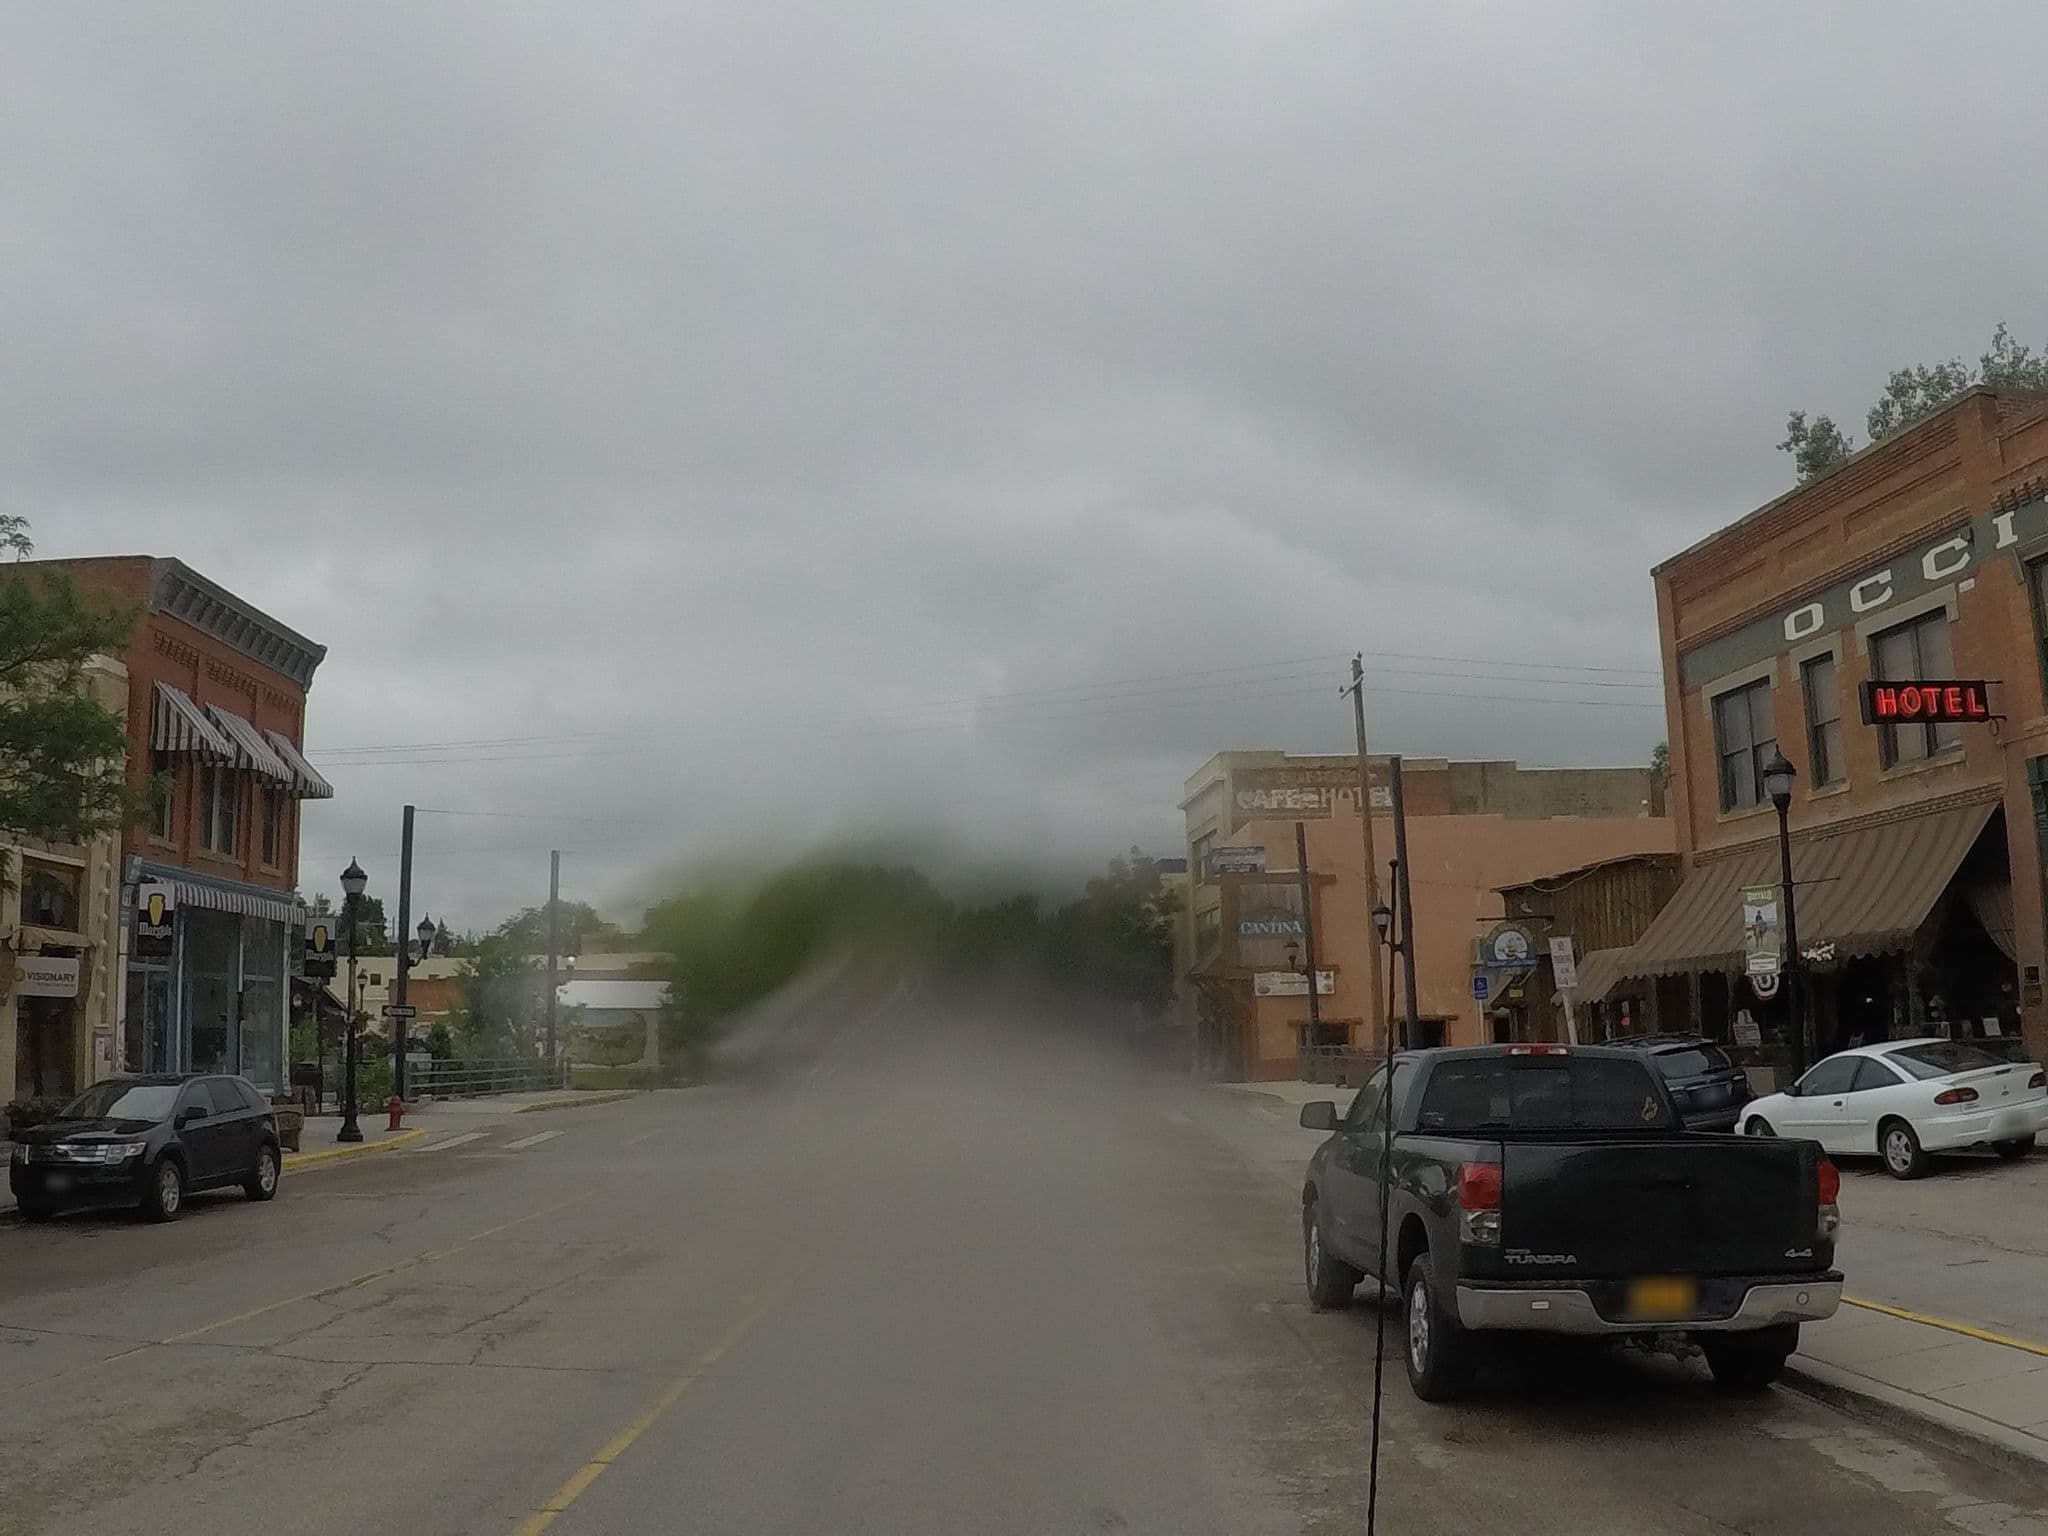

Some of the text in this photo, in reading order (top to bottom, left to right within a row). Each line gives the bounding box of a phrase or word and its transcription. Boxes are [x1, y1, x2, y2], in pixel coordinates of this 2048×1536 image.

[1783, 494, 2048, 641] OCCI
[1874, 686, 1987, 717] HOTEL
[1240, 920, 1303, 934] CANTINA
[26, 971, 75, 983] VISIONARY
[1503, 1254, 1577, 1264] TUNDRA
